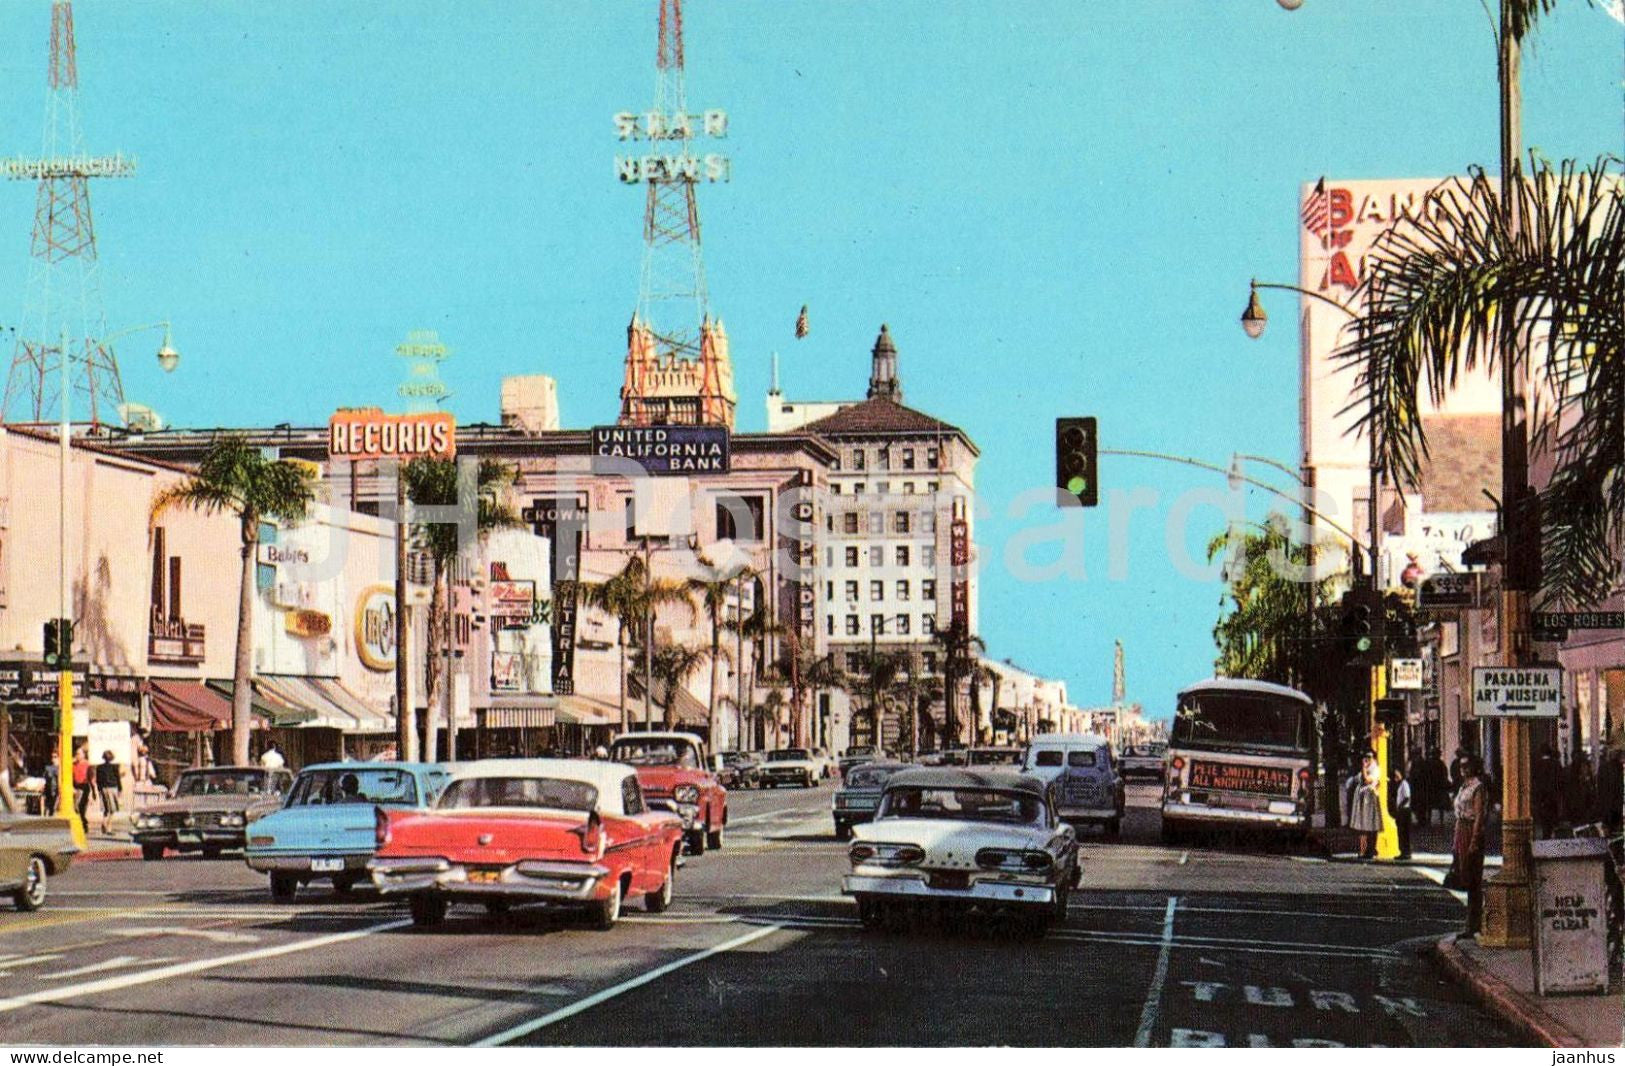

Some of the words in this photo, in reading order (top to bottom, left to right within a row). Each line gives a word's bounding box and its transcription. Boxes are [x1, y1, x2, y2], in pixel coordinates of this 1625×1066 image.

[613, 110, 728, 140] STAR
[614, 155, 729, 183] NEWS
[332, 421, 449, 454] RECORDS
[599, 430, 667, 442] UNITED
[599, 443, 722, 456] CALIFORNIA
[670, 458, 722, 470] BANK
[524, 509, 588, 522] CROWN
[800, 470, 813, 638] INDEPENDEN
[1544, 614, 1567, 627] LOS
[1573, 614, 1622, 628] ROBLES
[1484, 672, 1549, 686] PASADENA
[1476, 689, 1499, 702] ART
[1505, 689, 1558, 702] MUSEUM
[1221, 767, 1254, 779] SMITH
[1257, 769, 1289, 783] PLAYS
